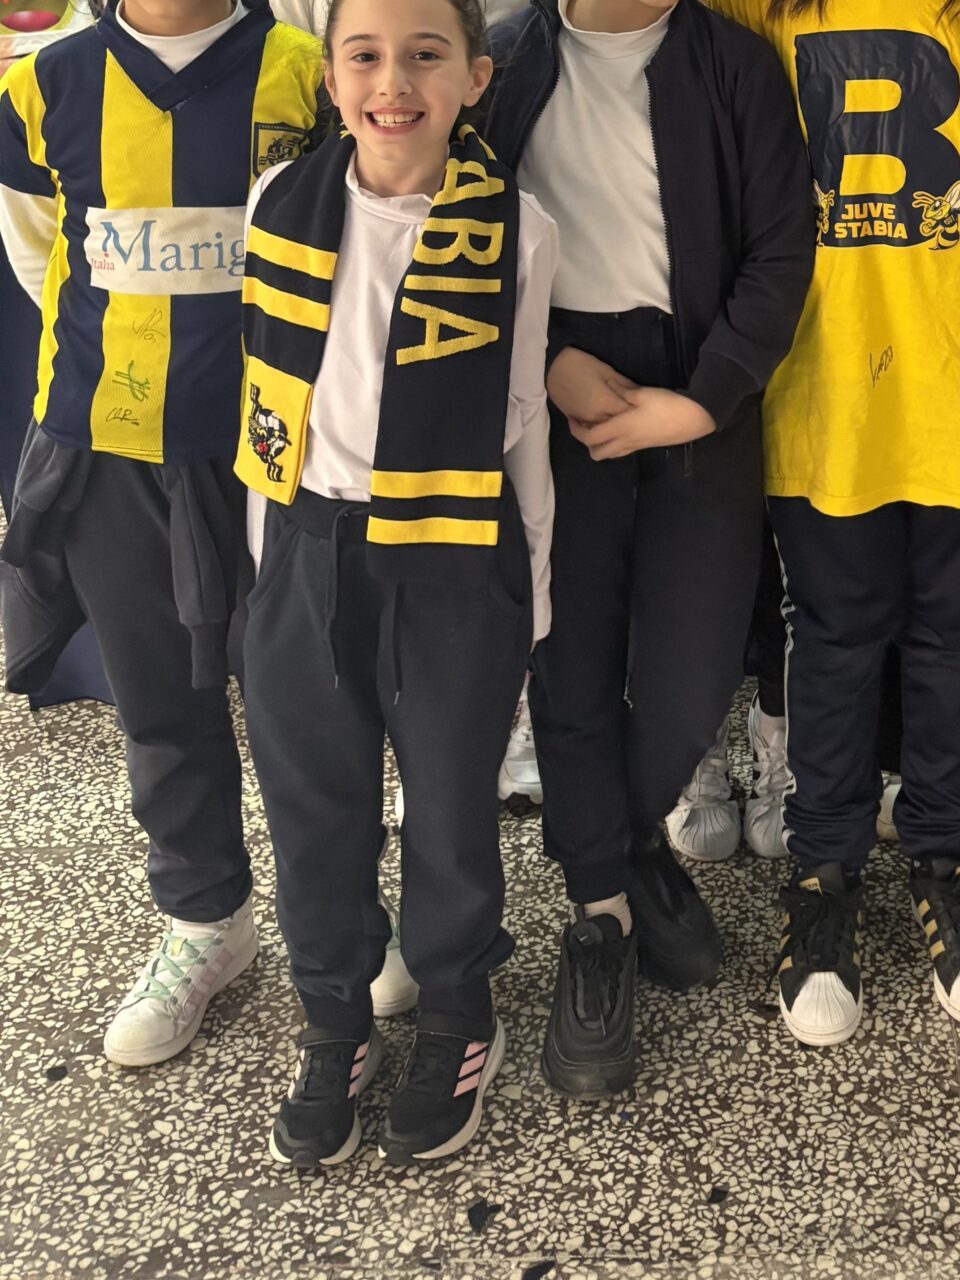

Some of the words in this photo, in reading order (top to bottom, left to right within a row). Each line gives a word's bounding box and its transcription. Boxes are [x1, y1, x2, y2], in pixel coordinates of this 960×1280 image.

[841, 202, 896, 220] JUVE
[833, 220, 908, 240] STABIA
[100, 220, 245, 277] Marig
